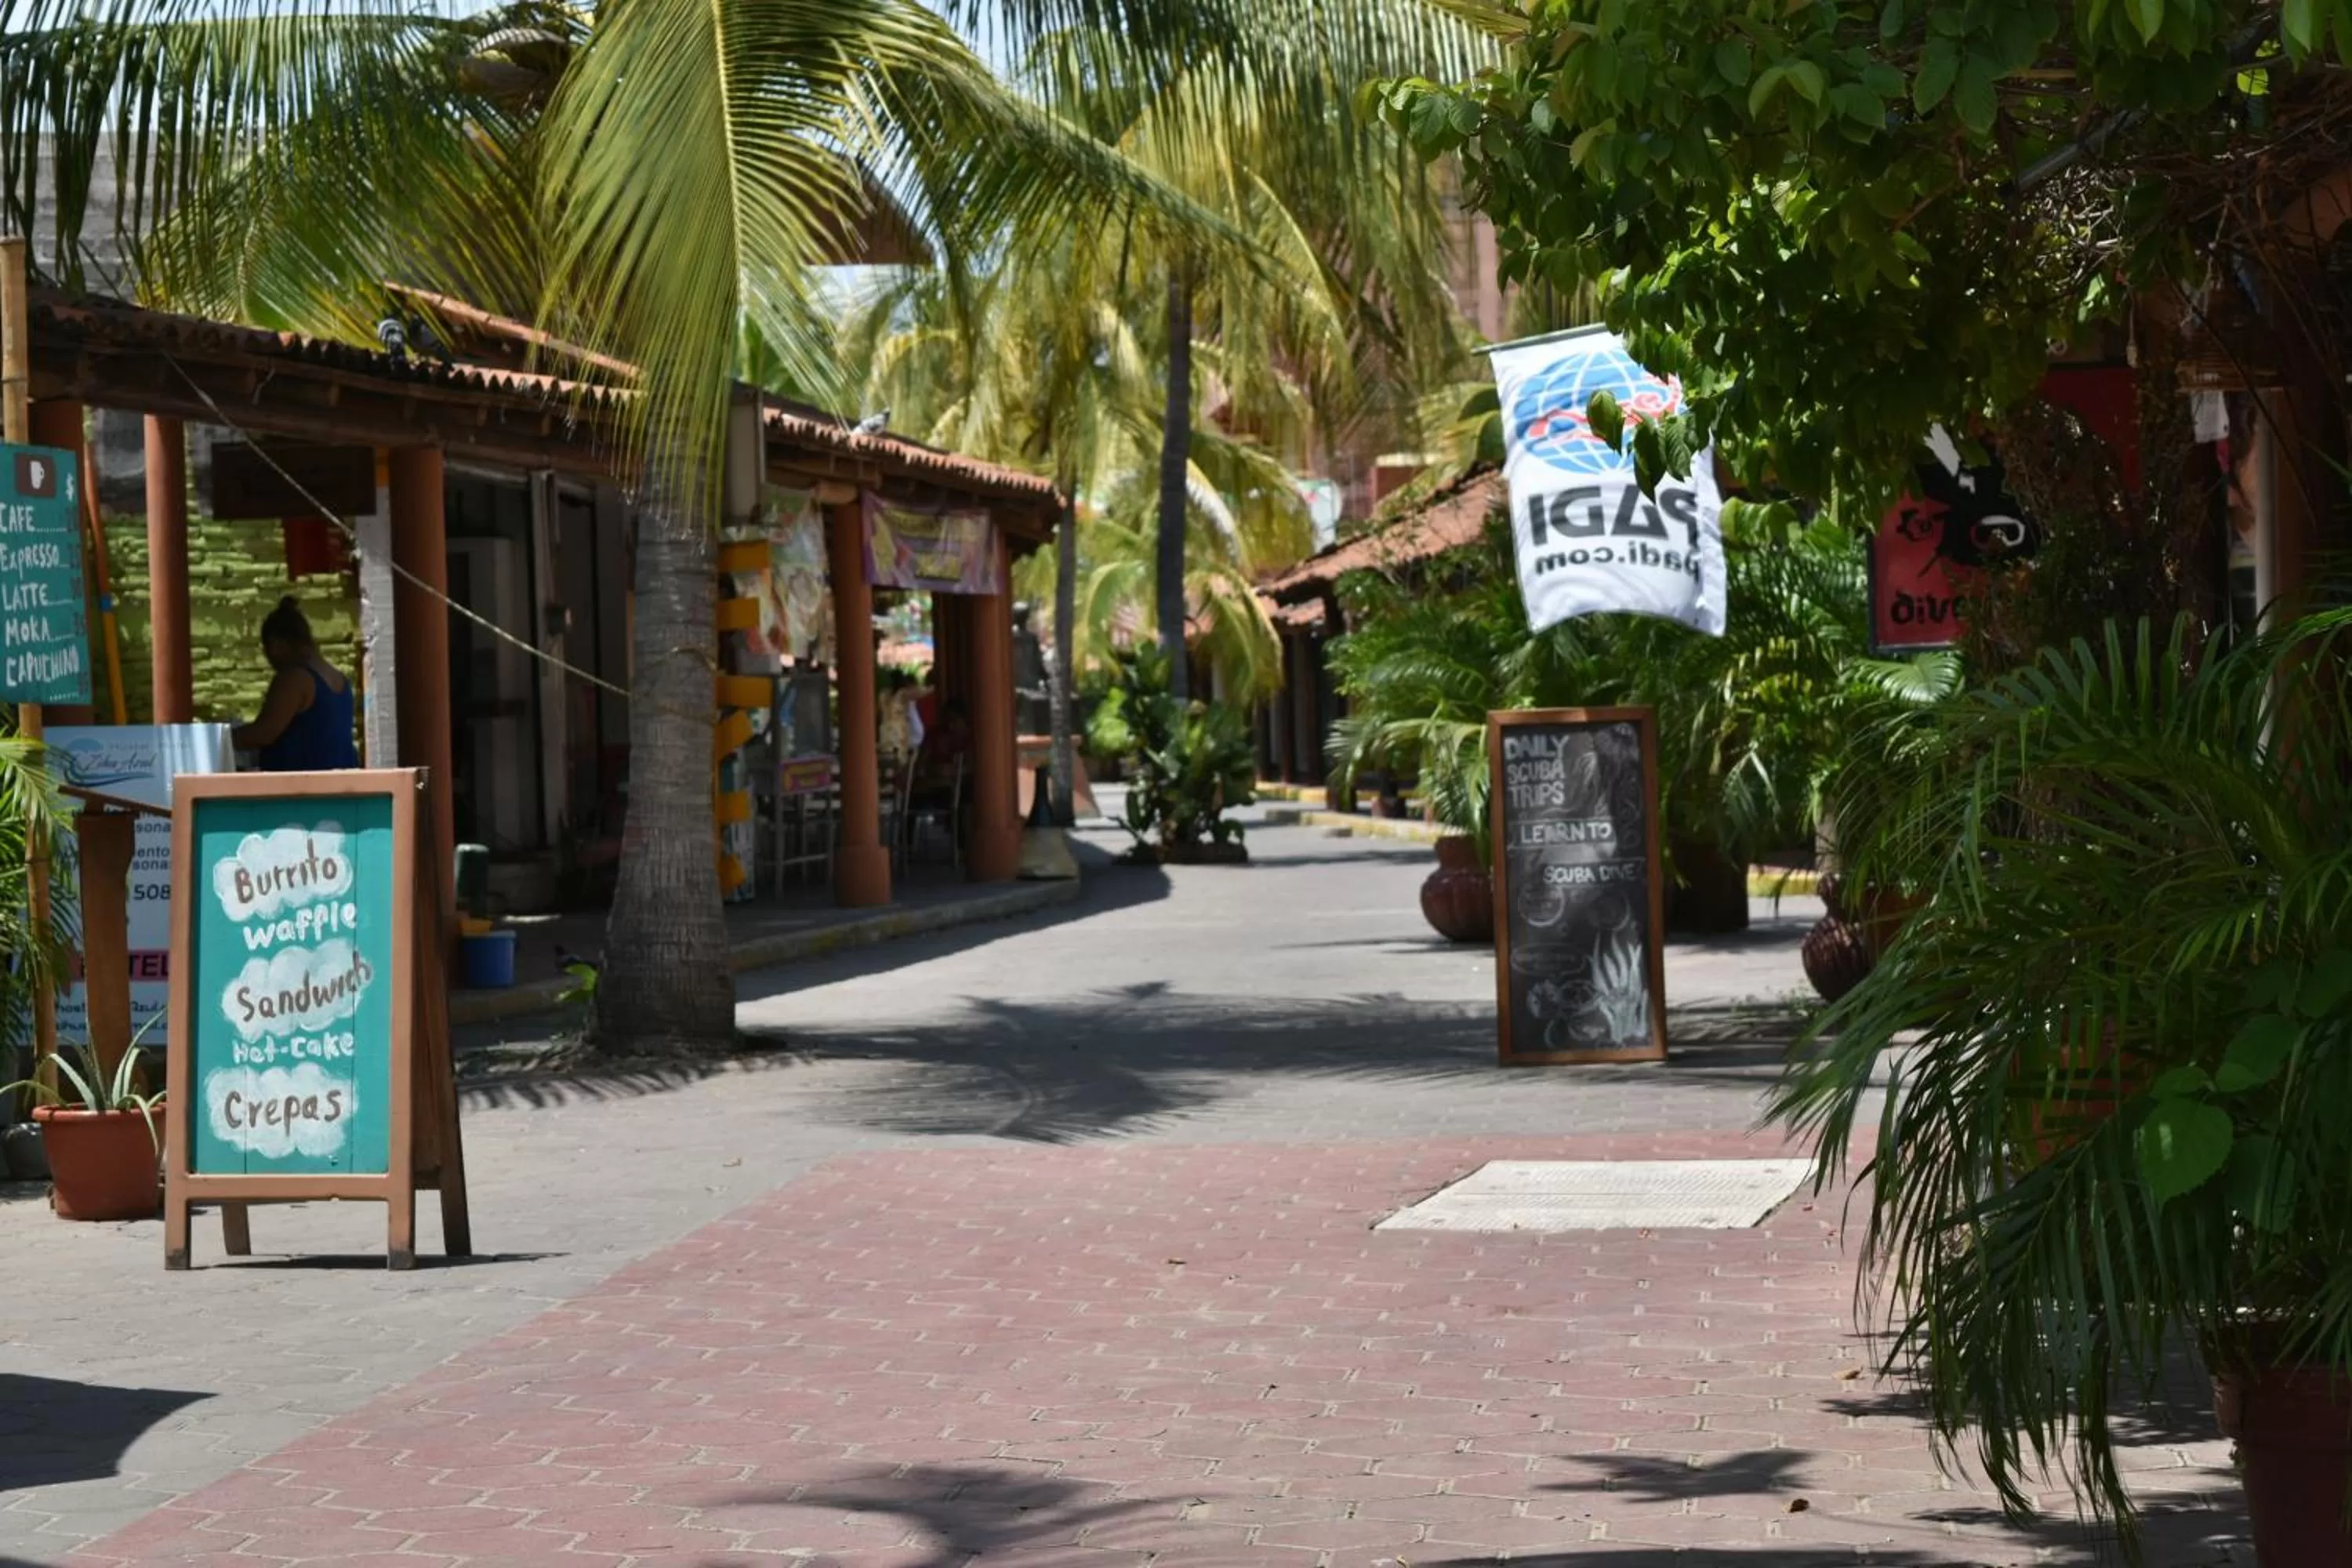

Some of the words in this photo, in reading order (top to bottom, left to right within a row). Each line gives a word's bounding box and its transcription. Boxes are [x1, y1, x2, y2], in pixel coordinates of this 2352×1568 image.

[2, 583, 49, 612] LATTE
[1504, 735, 1570, 760] DAILY
[1507, 759, 1566, 784] SCUBA
[1508, 781, 1565, 808] TRIPS
[1521, 822, 1585, 844] LEARN
[1587, 822, 1612, 839] TO
[235, 839, 337, 903] Burrito
[1543, 865, 1595, 883] SCUBA
[1599, 863, 1635, 881] DIVE
[238, 950, 371, 1022] Sandwich
[224, 1088, 342, 1136] Crepas
